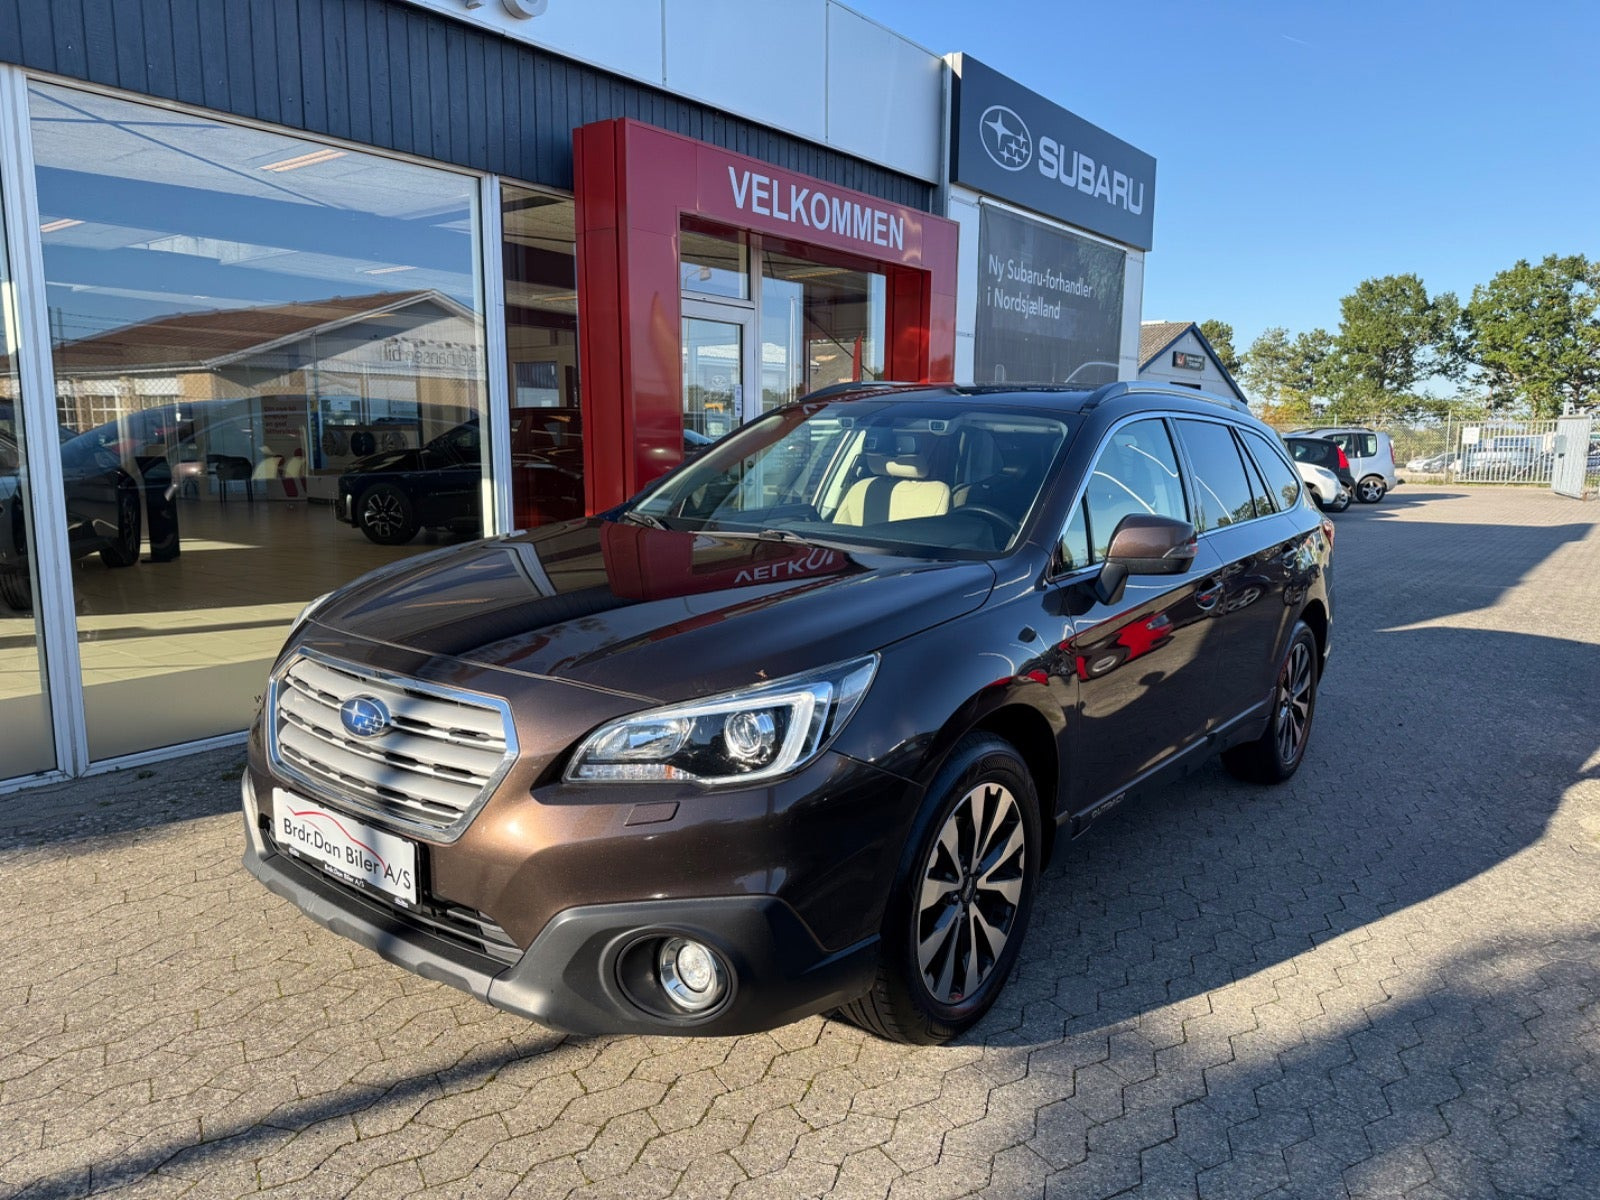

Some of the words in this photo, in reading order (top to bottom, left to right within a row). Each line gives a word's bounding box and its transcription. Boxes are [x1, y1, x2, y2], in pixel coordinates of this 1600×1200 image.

[1038, 135, 1144, 215] SUBARU
[728, 165, 904, 250] VELKOMMEN
[988, 254, 1005, 282] Ny
[1007, 258, 1093, 298] Subaru-forhandler
[987, 286, 991, 307] i
[994, 287, 1061, 319] Nordsjælland
[346, 846, 380, 875] Biler
[384, 863, 411, 890] A/S
